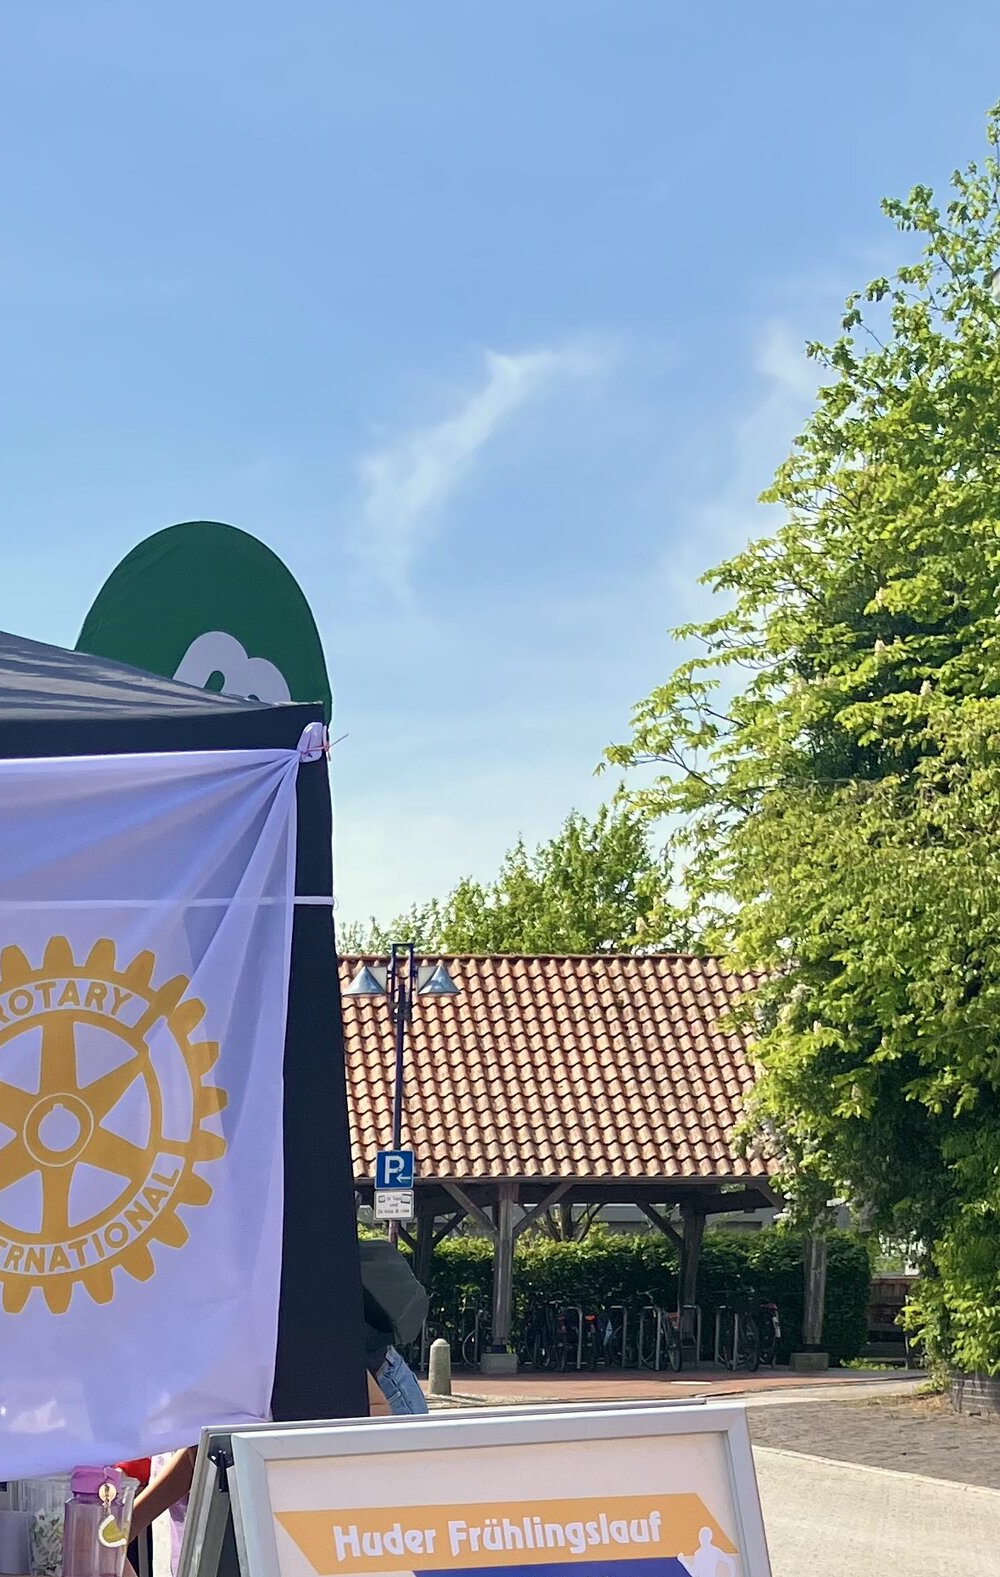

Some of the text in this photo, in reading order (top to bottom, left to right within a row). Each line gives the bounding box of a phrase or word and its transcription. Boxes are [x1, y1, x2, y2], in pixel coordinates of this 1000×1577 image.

[384, 1155, 405, 1184] P
[333, 1511, 662, 1561] Huder Frühlingslauf
